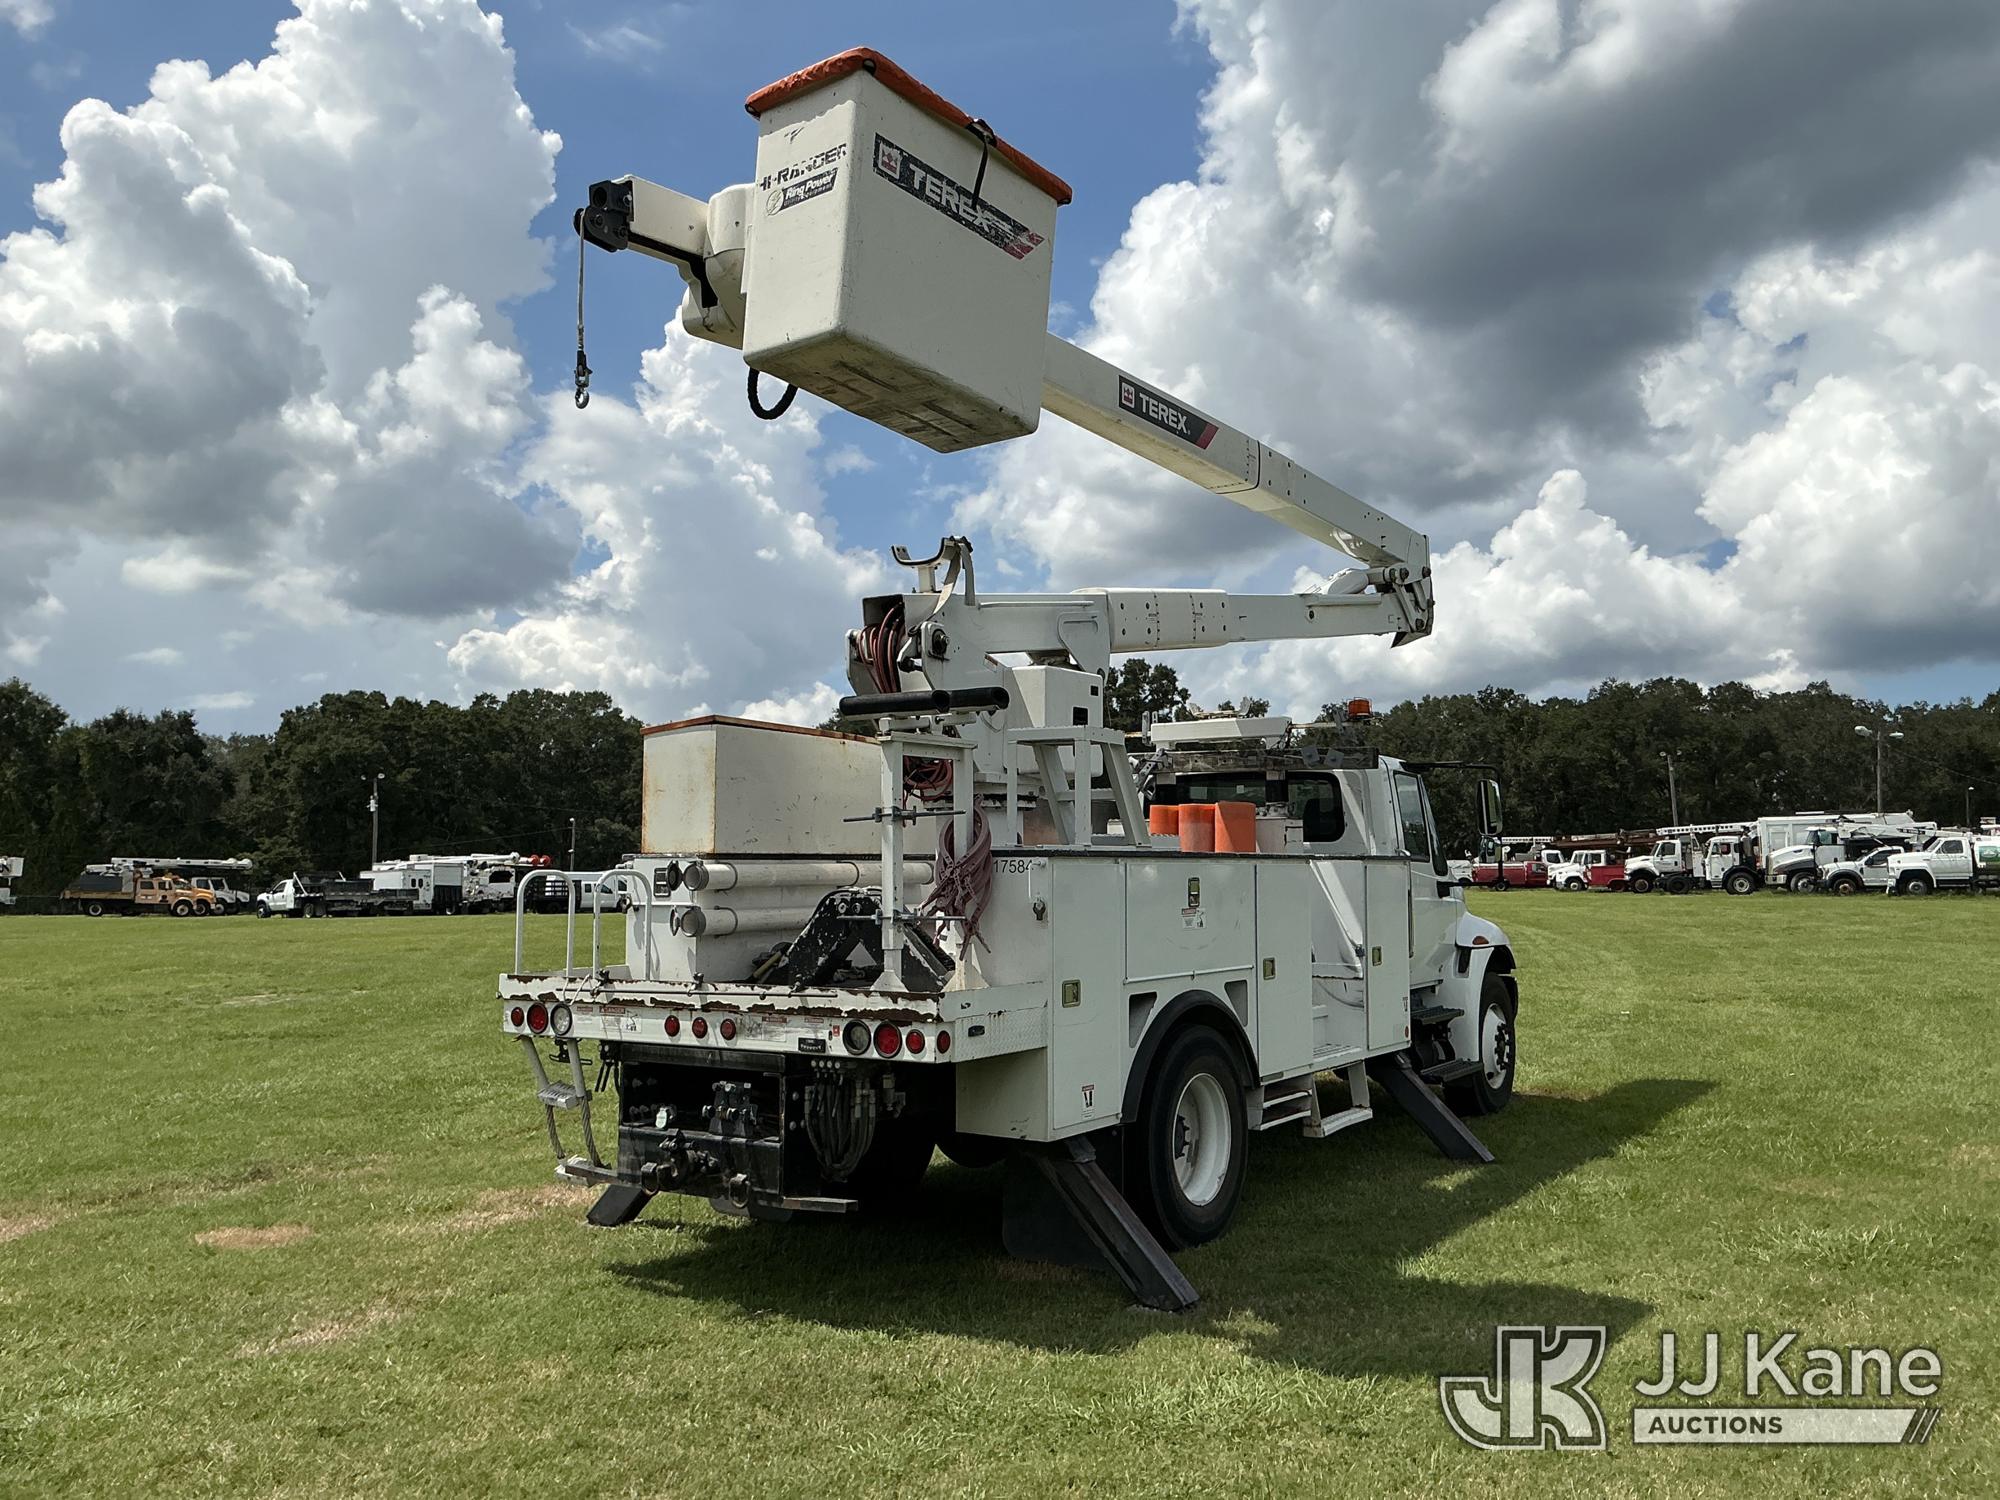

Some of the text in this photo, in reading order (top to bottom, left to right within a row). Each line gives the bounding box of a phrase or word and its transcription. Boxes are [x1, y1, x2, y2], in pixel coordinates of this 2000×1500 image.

[785, 174, 834, 200] Ring Power
[908, 163, 991, 231] TEREX
[1139, 392, 1188, 434] TEREX
